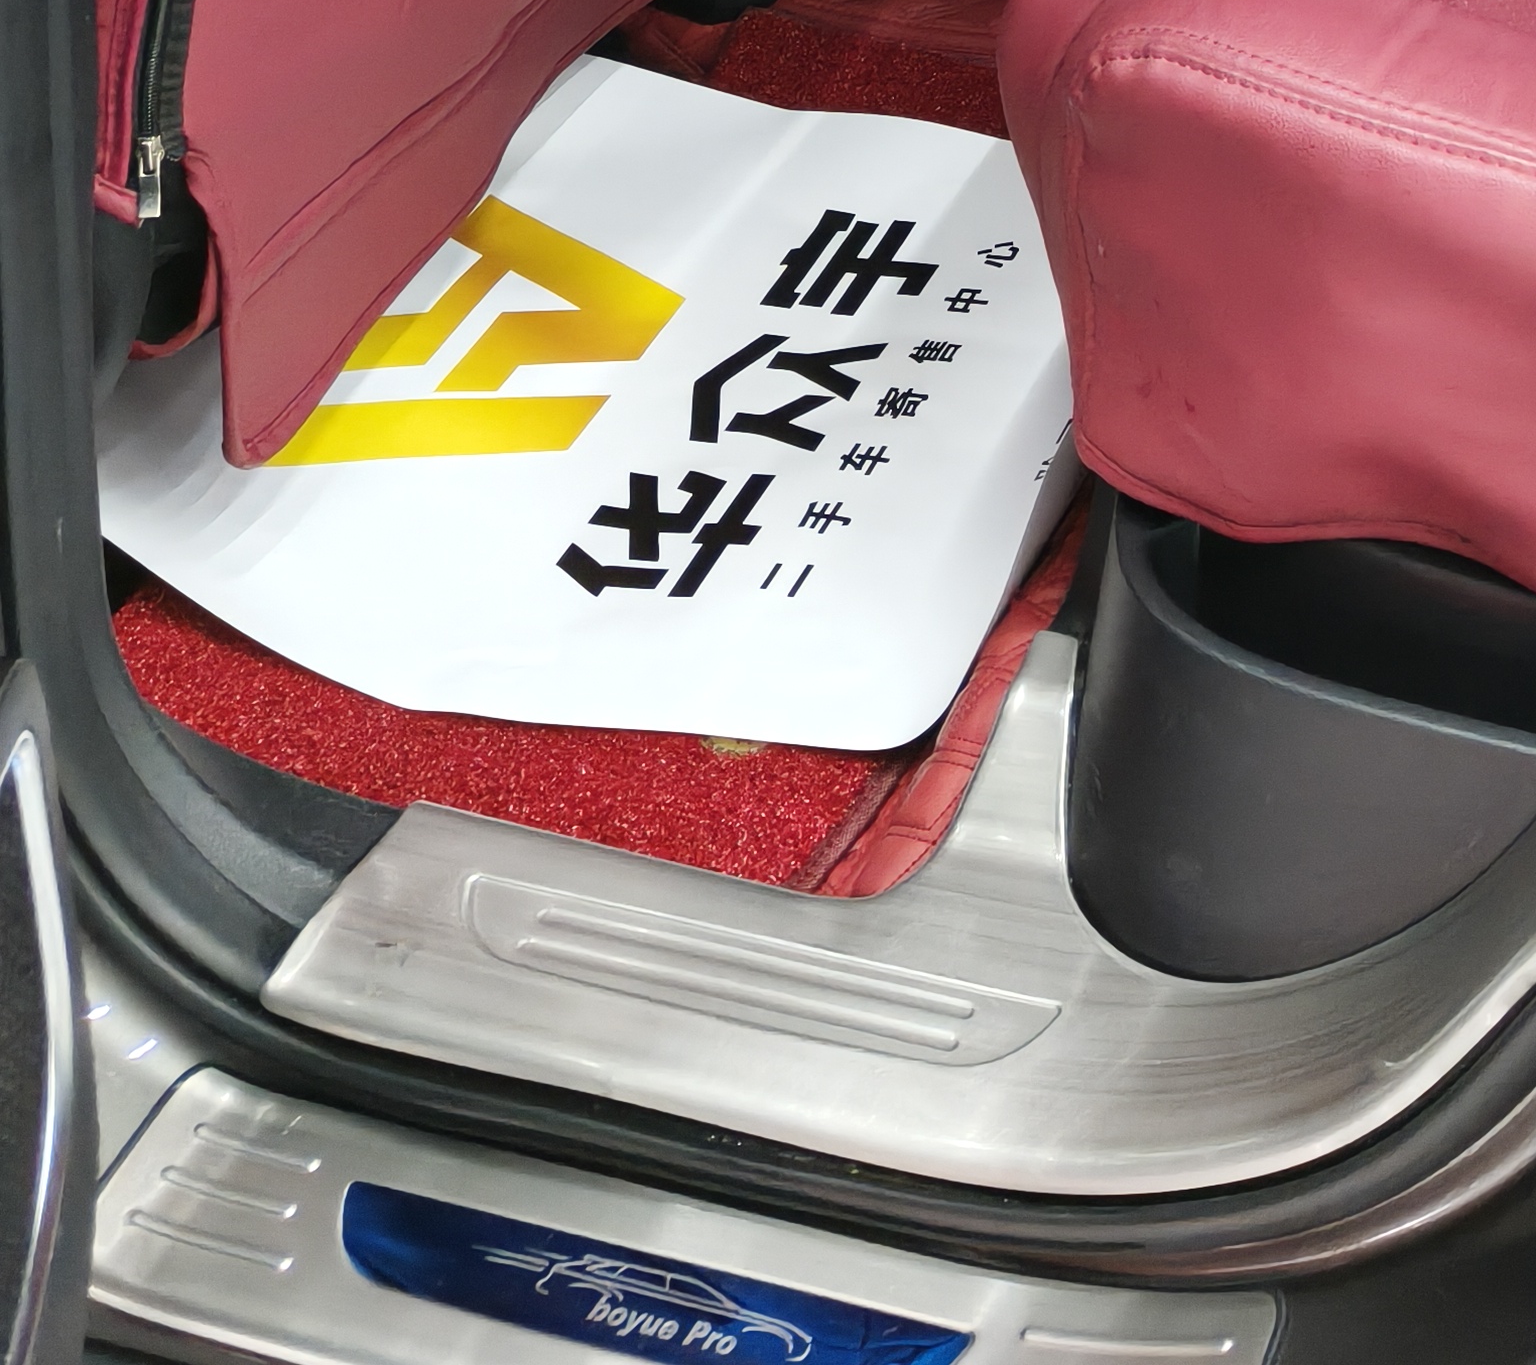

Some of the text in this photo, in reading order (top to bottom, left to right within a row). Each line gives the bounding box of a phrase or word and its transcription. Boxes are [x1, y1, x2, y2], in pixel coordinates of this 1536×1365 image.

[556, 209, 940, 598] 华众宇
[760, 241, 1020, 598] 二手车寄售中心
[682, 1320, 737, 1356] Pro
